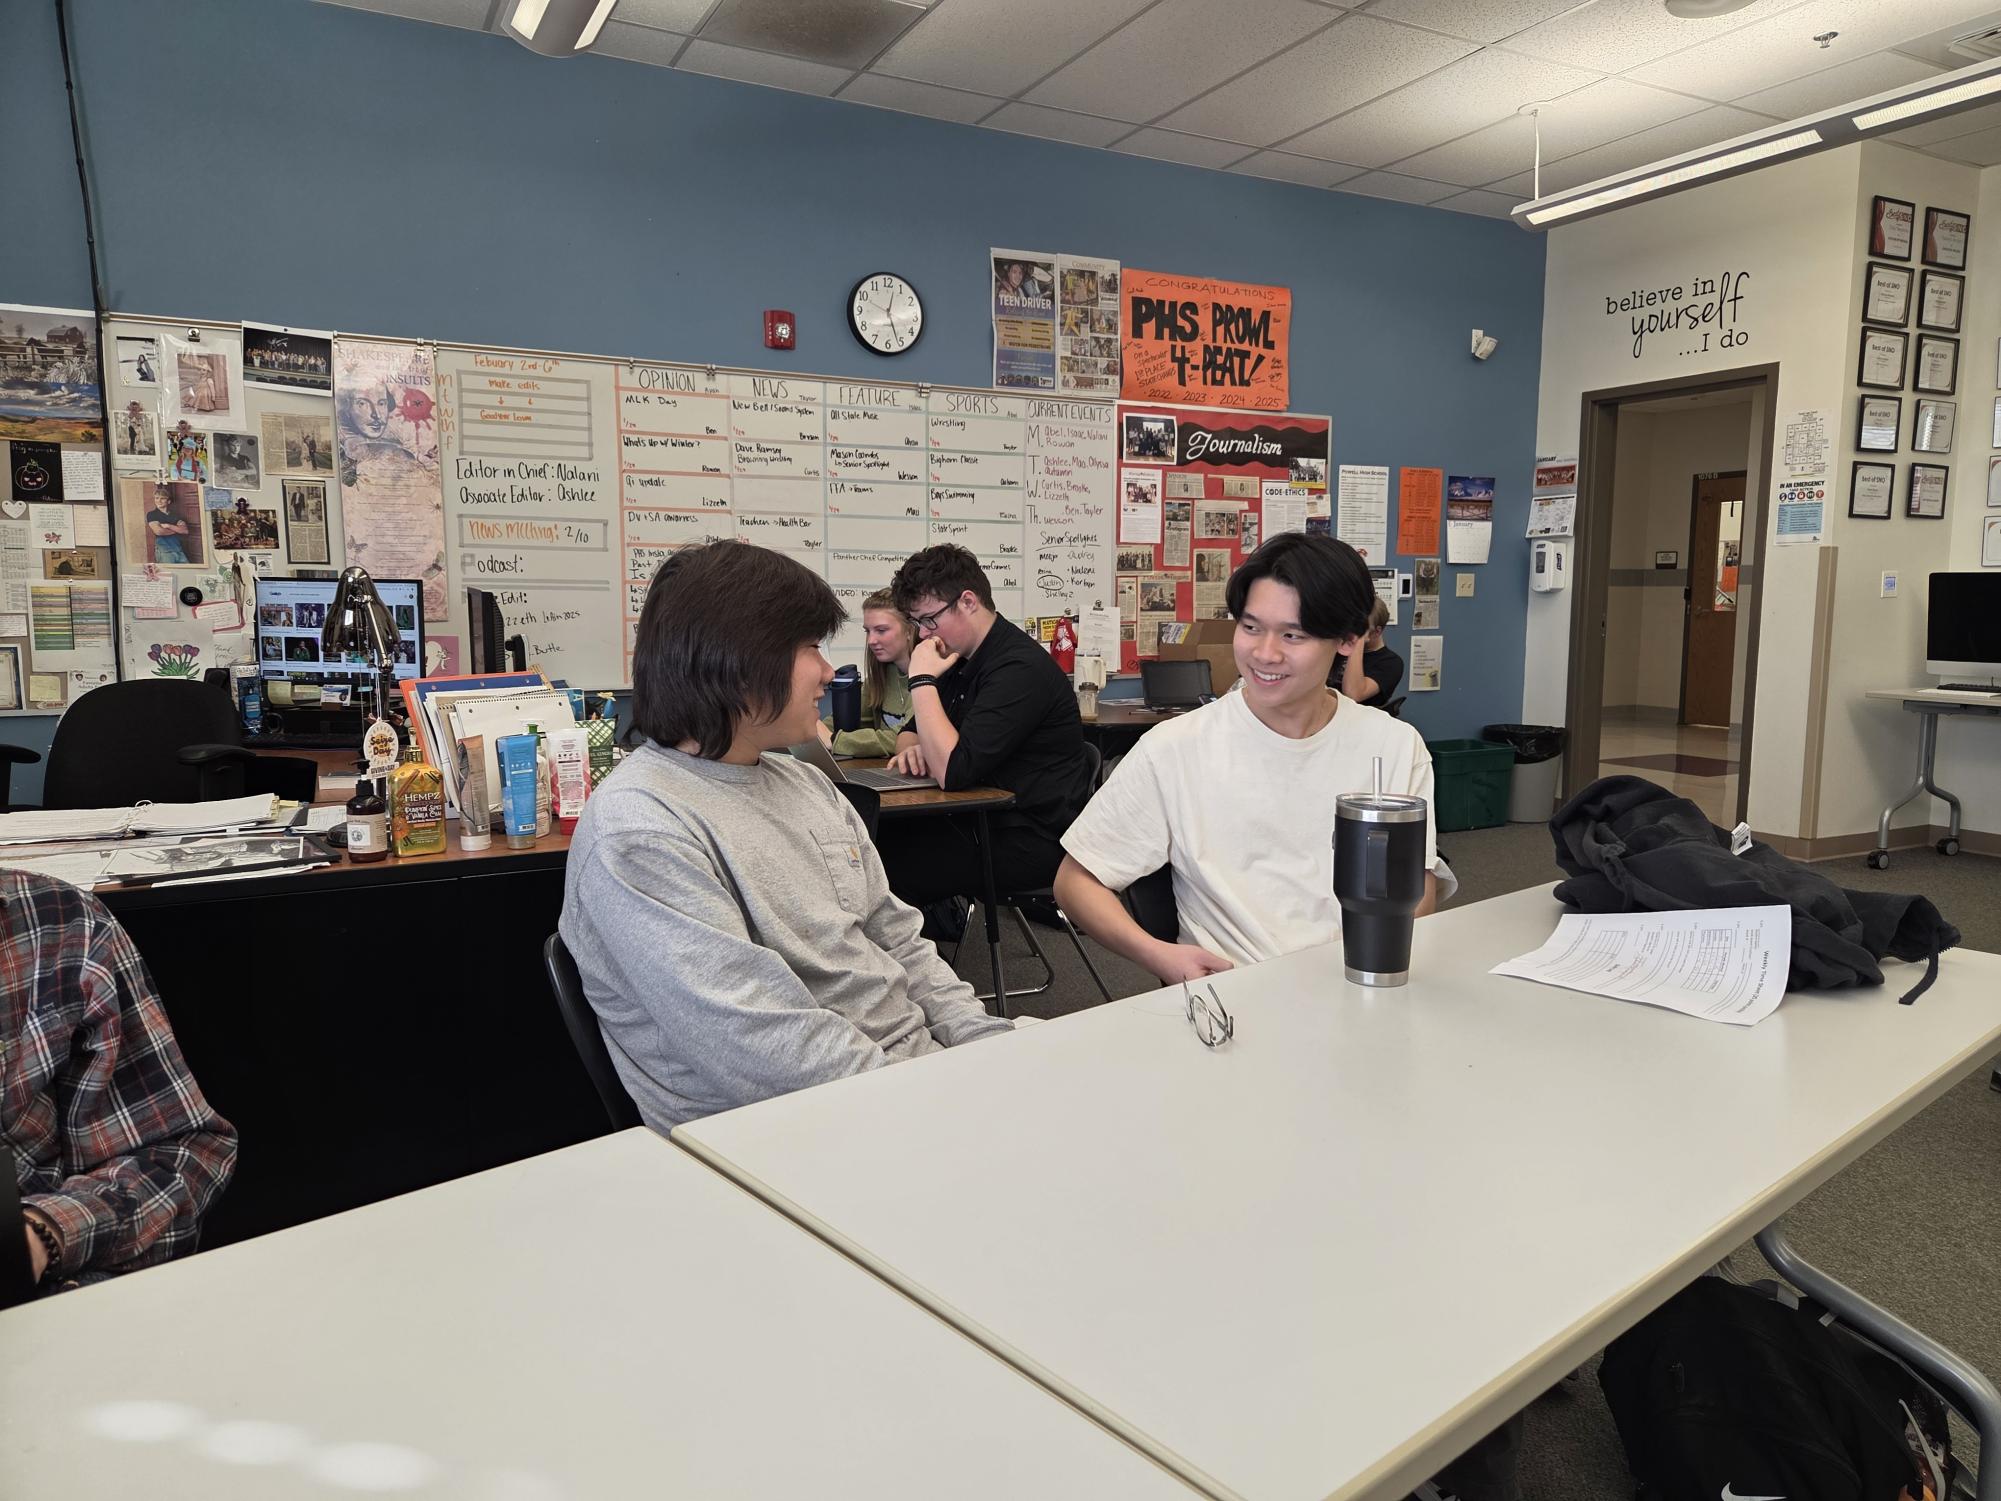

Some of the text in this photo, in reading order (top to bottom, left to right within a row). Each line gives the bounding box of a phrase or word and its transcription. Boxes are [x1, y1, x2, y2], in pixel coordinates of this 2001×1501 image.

[871, 281, 878, 291] 11
[883, 277, 893, 288] 12
[899, 284, 903, 294] 1
[1145, 277, 1276, 300] CONGRATULATIONS
[859, 290, 868, 301] 10
[908, 296, 914, 306] 2
[1606, 278, 1716, 315] believe in
[999, 294, 1052, 310] TEEN DRIVER
[856, 305, 862, 316] 9
[1632, 272, 1750, 358] yourself
[861, 321, 867, 331] 8
[1131, 296, 1275, 350] PHS PROWL
[908, 326, 914, 336] 4
[871, 334, 878, 344] 7
[885, 339, 891, 349] 6
[899, 337, 904, 347] 5
[1720, 329, 1748, 348] do
[474, 354, 514, 370] Febuary
[1170, 344, 1265, 387] 4-PEAT!
[386, 374, 431, 385] INSULTS
[638, 368, 696, 392] OPINION
[518, 380, 540, 391] edits
[753, 378, 788, 398] NEWS
[625, 395, 677, 407] MLK Day
[840, 385, 901, 407] FEATURE
[1148, 389, 1281, 408] 2022 2023 2024 2025
[732, 400, 750, 410] New
[946, 393, 999, 414] SPORTS
[1028, 400, 1112, 423] CURRENT EVENTS
[931, 418, 966, 431] Wrestling
[735, 442, 754, 452] Dave
[1046, 438, 1075, 448] Rowan
[1186, 430, 1282, 460] Journalism
[830, 448, 853, 459] Mason
[930, 454, 958, 468] Bighorn
[456, 458, 500, 480] Editor
[503, 467, 516, 479] in
[557, 463, 600, 481] Nalani
[1265, 488, 1282, 496] CODE
[628, 511, 641, 522] DV
[565, 525, 589, 544] 2/10
[1040, 530, 1064, 545] Senior
[370, 736, 394, 747] Seize
[373, 746, 392, 756] Day
[404, 792, 441, 802] HEMPZ
